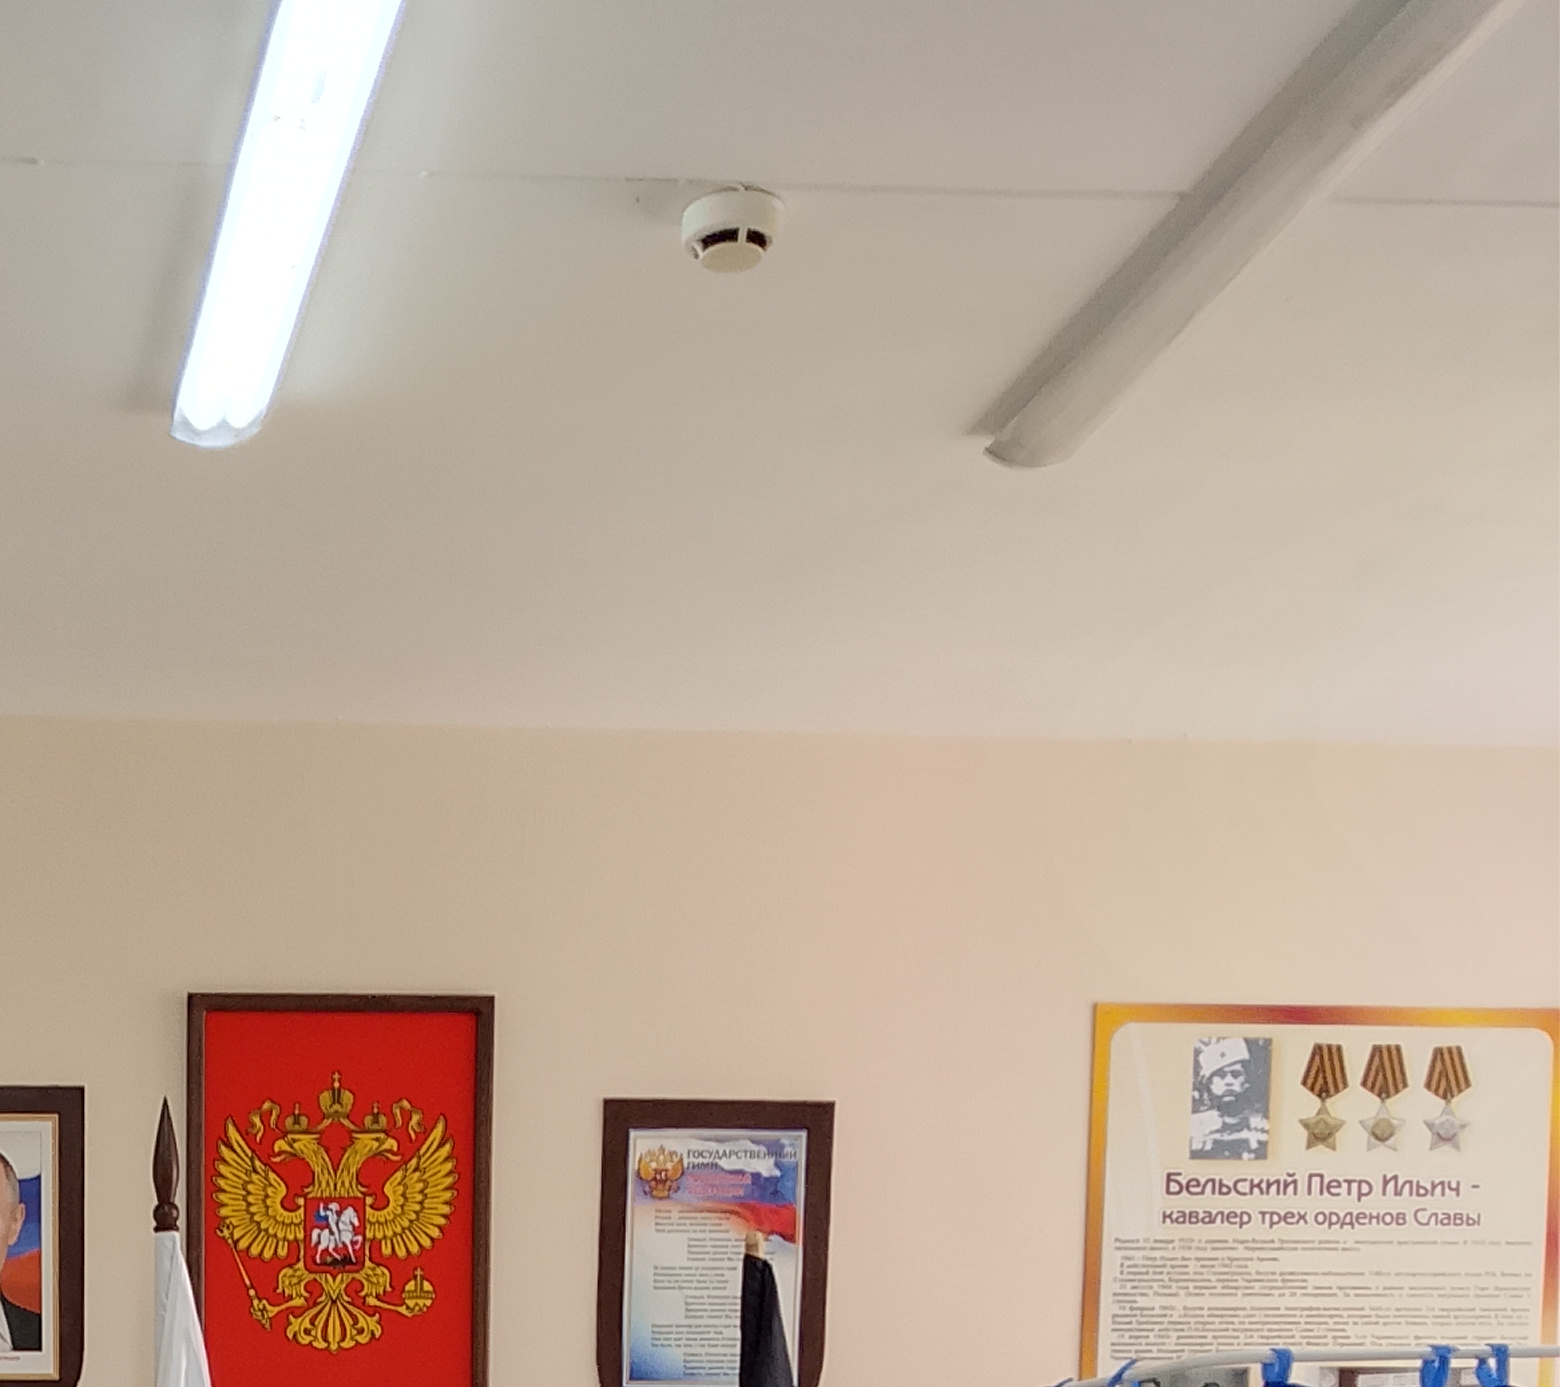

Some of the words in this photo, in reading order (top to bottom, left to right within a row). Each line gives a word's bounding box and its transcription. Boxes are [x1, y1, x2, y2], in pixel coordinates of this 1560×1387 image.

[1164, 1172, 1299, 1197] Бельский
[1306, 1172, 1374, 1202] Петр
[1381, 1173, 1461, 1198] Ильич
[1161, 1209, 1252, 1229] кавалер
[1258, 1210, 1309, 1229] трех
[1313, 1210, 1407, 1230] орденов
[1413, 1208, 1482, 1227] Славы
